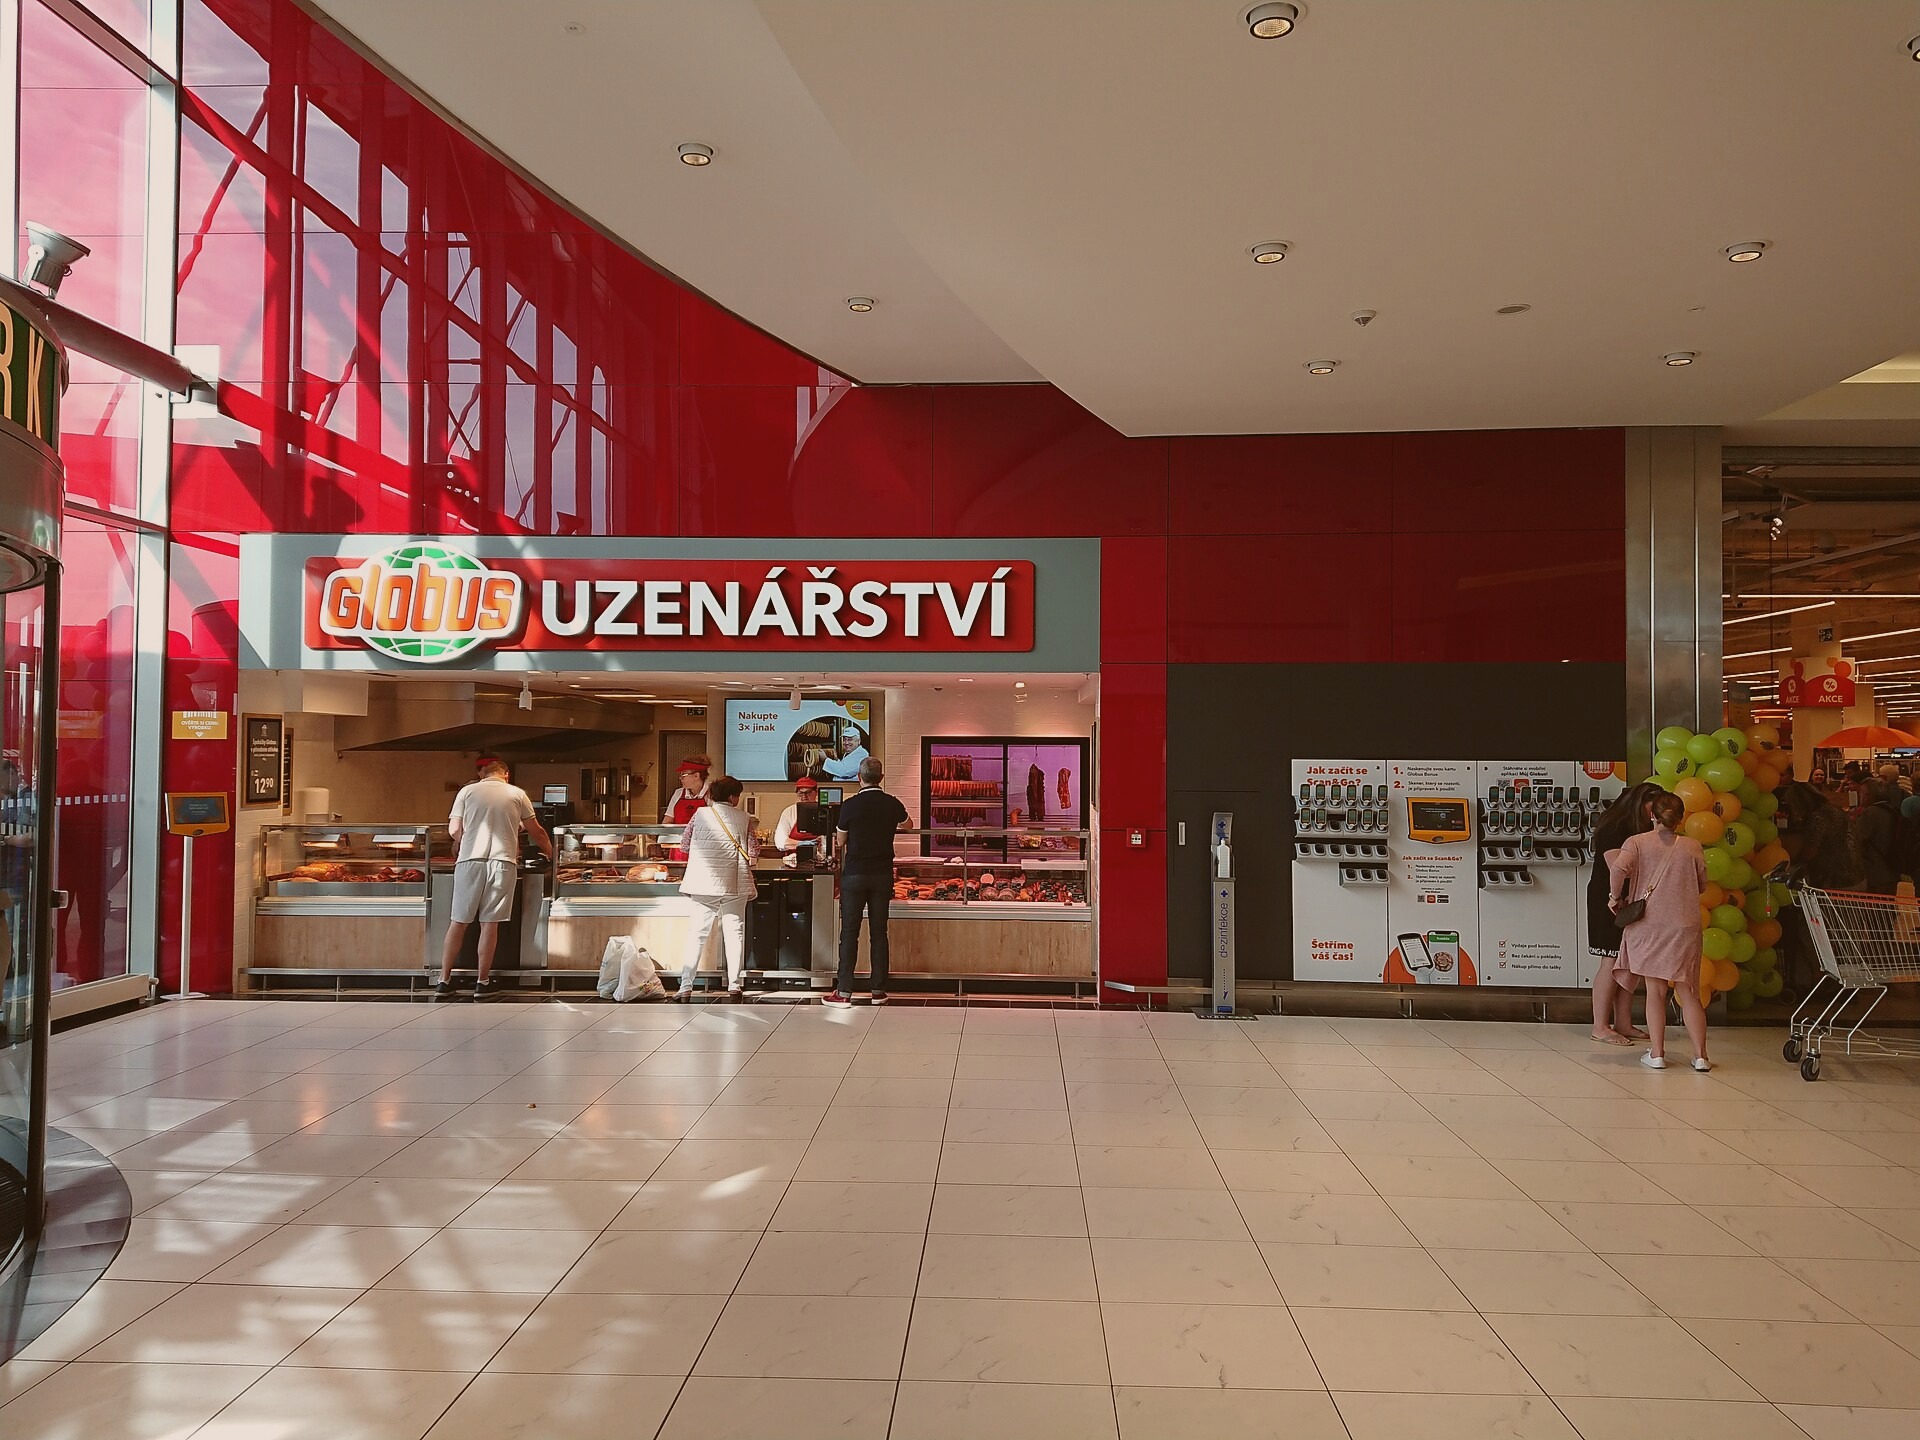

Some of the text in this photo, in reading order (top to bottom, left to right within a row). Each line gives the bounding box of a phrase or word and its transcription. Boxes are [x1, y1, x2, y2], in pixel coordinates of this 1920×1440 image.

[327, 562, 516, 632] Globus
[540, 566, 1013, 638] UZENÁŘSTVÍ
[1785, 695, 1800, 704] AKCE
[1818, 695, 1844, 703] AKCE
[738, 711, 779, 721] Nakupte
[752, 723, 776, 733] jinak
[1306, 766, 1368, 775] Jak začít se
[1393, 766, 1404, 775] 1.
[1393, 780, 1405, 789] 2.
[1218, 902, 1229, 958] dezinfekce
[1311, 938, 1354, 950] Šetříme
[1511, 942, 1527, 950] Výdaje
[1311, 951, 1354, 961] váš čas!
